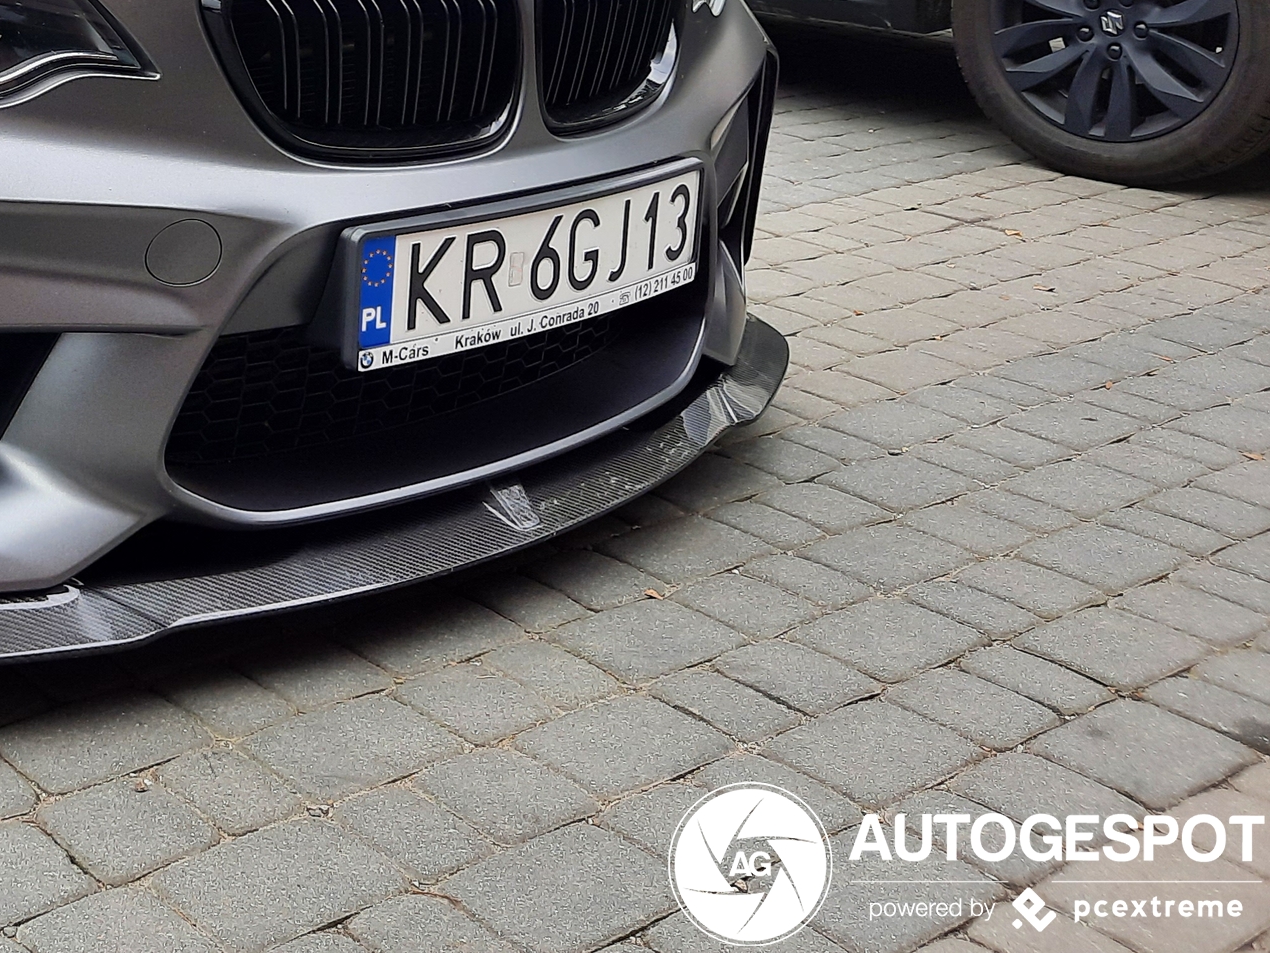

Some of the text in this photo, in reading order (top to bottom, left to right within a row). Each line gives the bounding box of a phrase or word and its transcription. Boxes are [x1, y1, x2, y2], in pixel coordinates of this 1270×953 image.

[407, 184, 691, 332] KR 6GJ13
[634, 265, 693, 302] (12) 211 45 00
[361, 307, 387, 333] PL
[381, 301, 600, 365] M-Cars Kraków ul. J. Conrada 20
